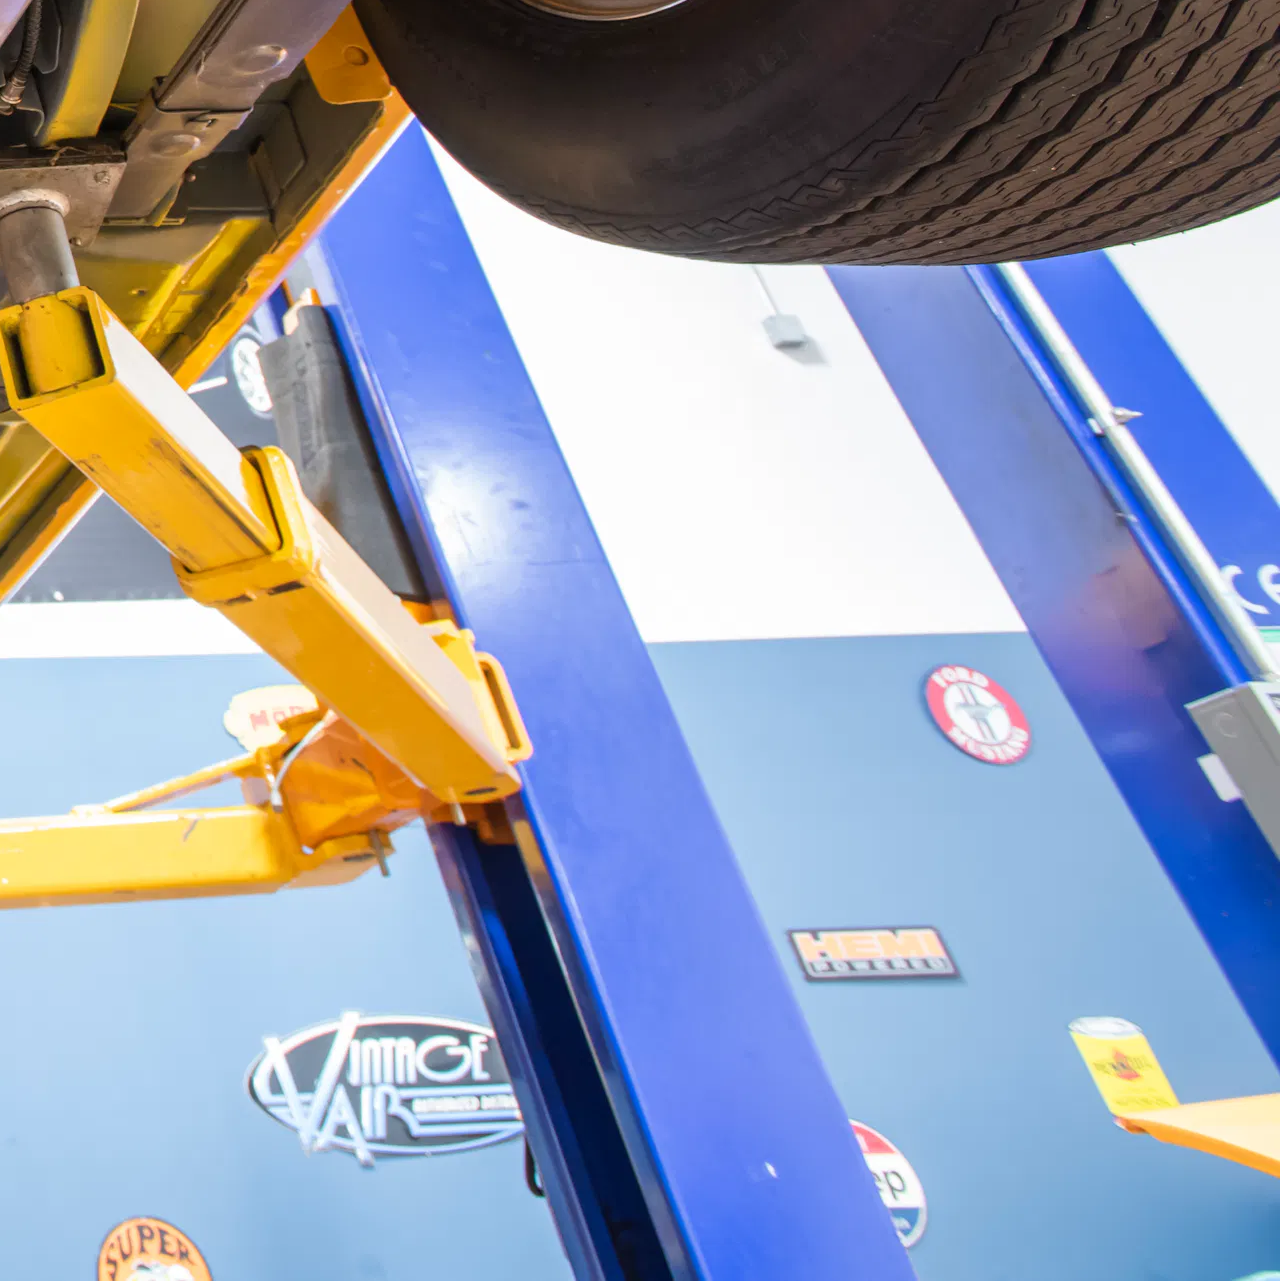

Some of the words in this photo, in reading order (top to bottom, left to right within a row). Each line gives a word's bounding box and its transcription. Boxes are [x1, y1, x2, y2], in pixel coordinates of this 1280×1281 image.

[931, 666, 989, 689] FORD
[948, 725, 1030, 761] MUSTANG
[792, 928, 946, 961] HEMI
[106, 1222, 198, 1281] SUPER
